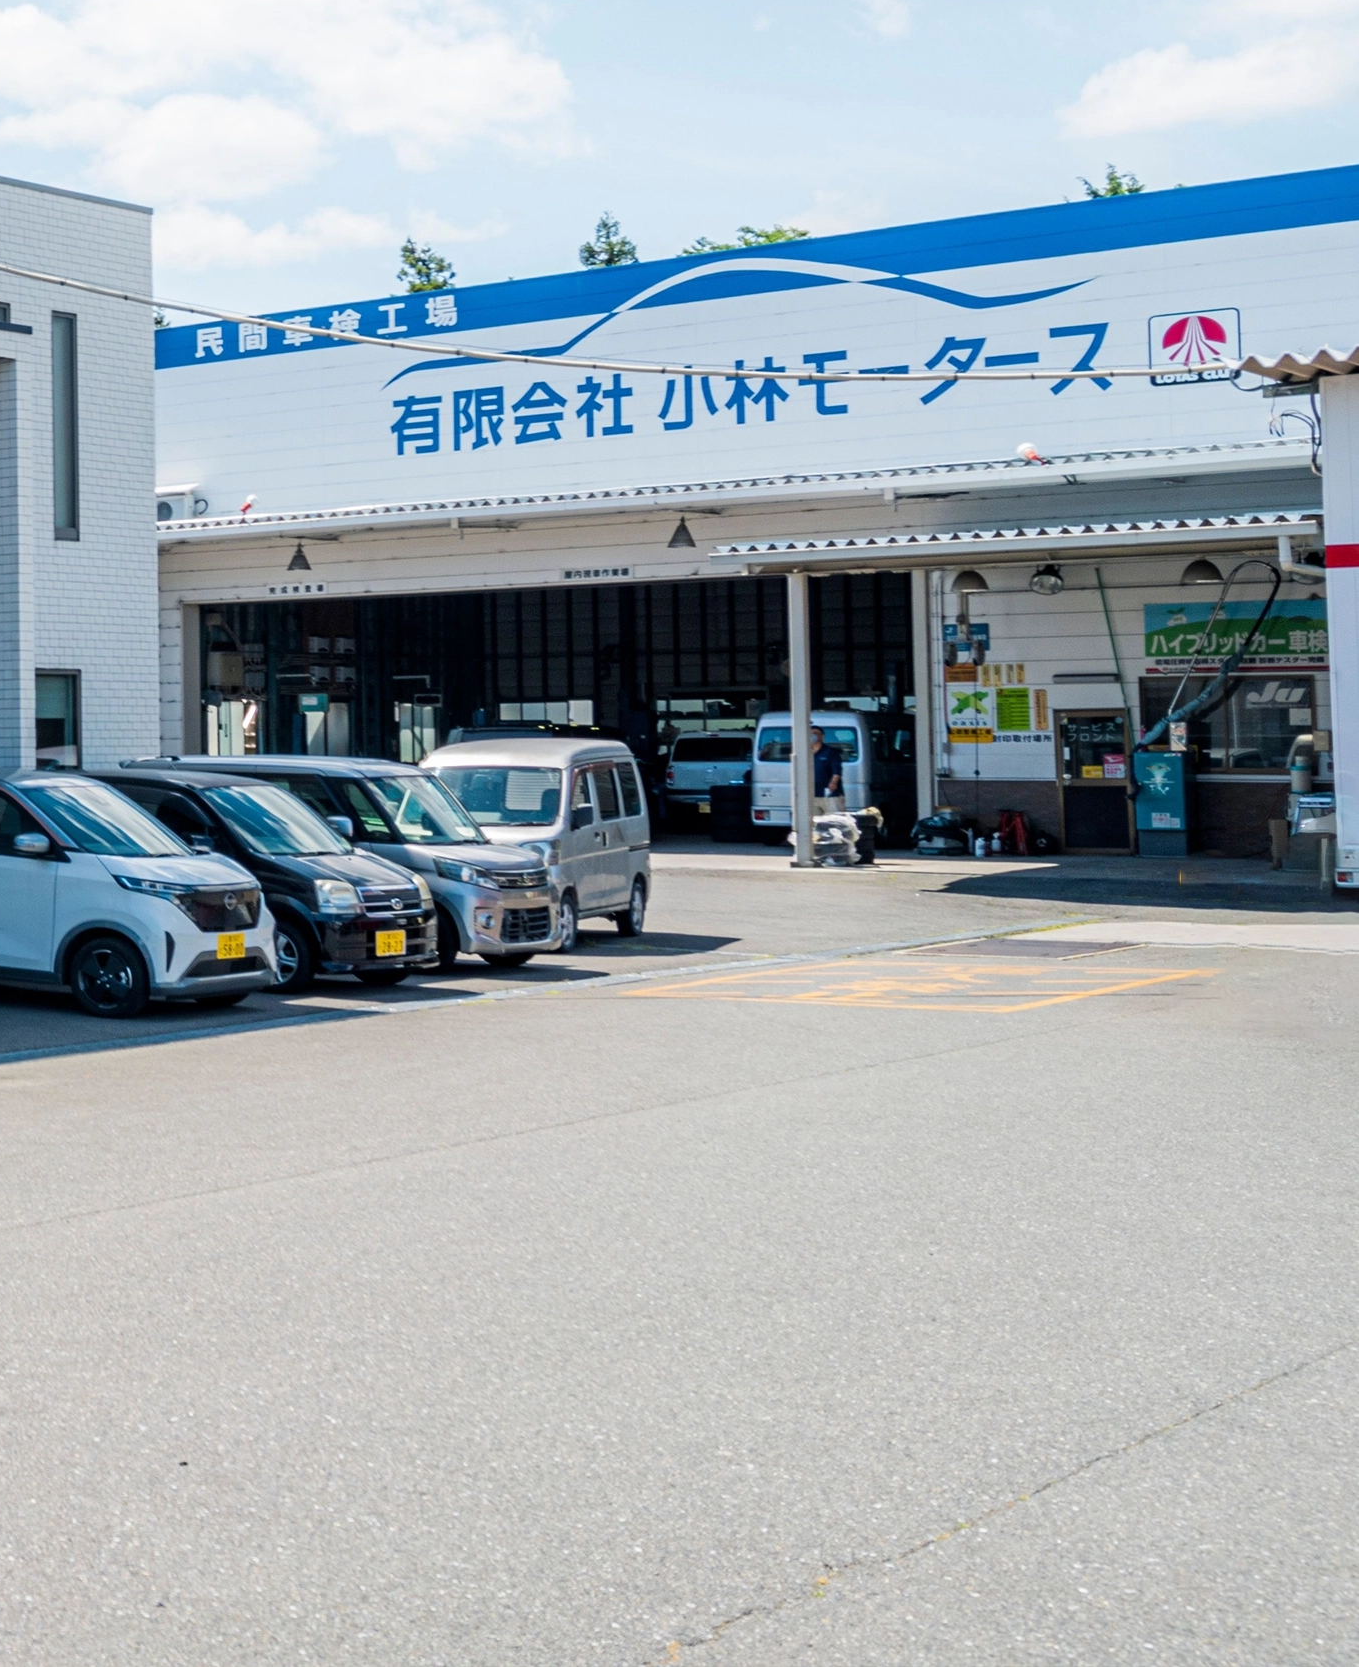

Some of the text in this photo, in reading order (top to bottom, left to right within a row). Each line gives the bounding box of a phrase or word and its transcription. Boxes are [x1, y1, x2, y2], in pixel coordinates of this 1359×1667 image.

[195, 294, 458, 358] 民間車検工場
[1155, 369, 1236, 384] LOTAS CLU
[390, 322, 1113, 456] 有限会社 小林モータース
[1246, 682, 1308, 702] Ju
[1067, 722, 1116, 732] サービス
[1067, 732, 1115, 742] フロント
